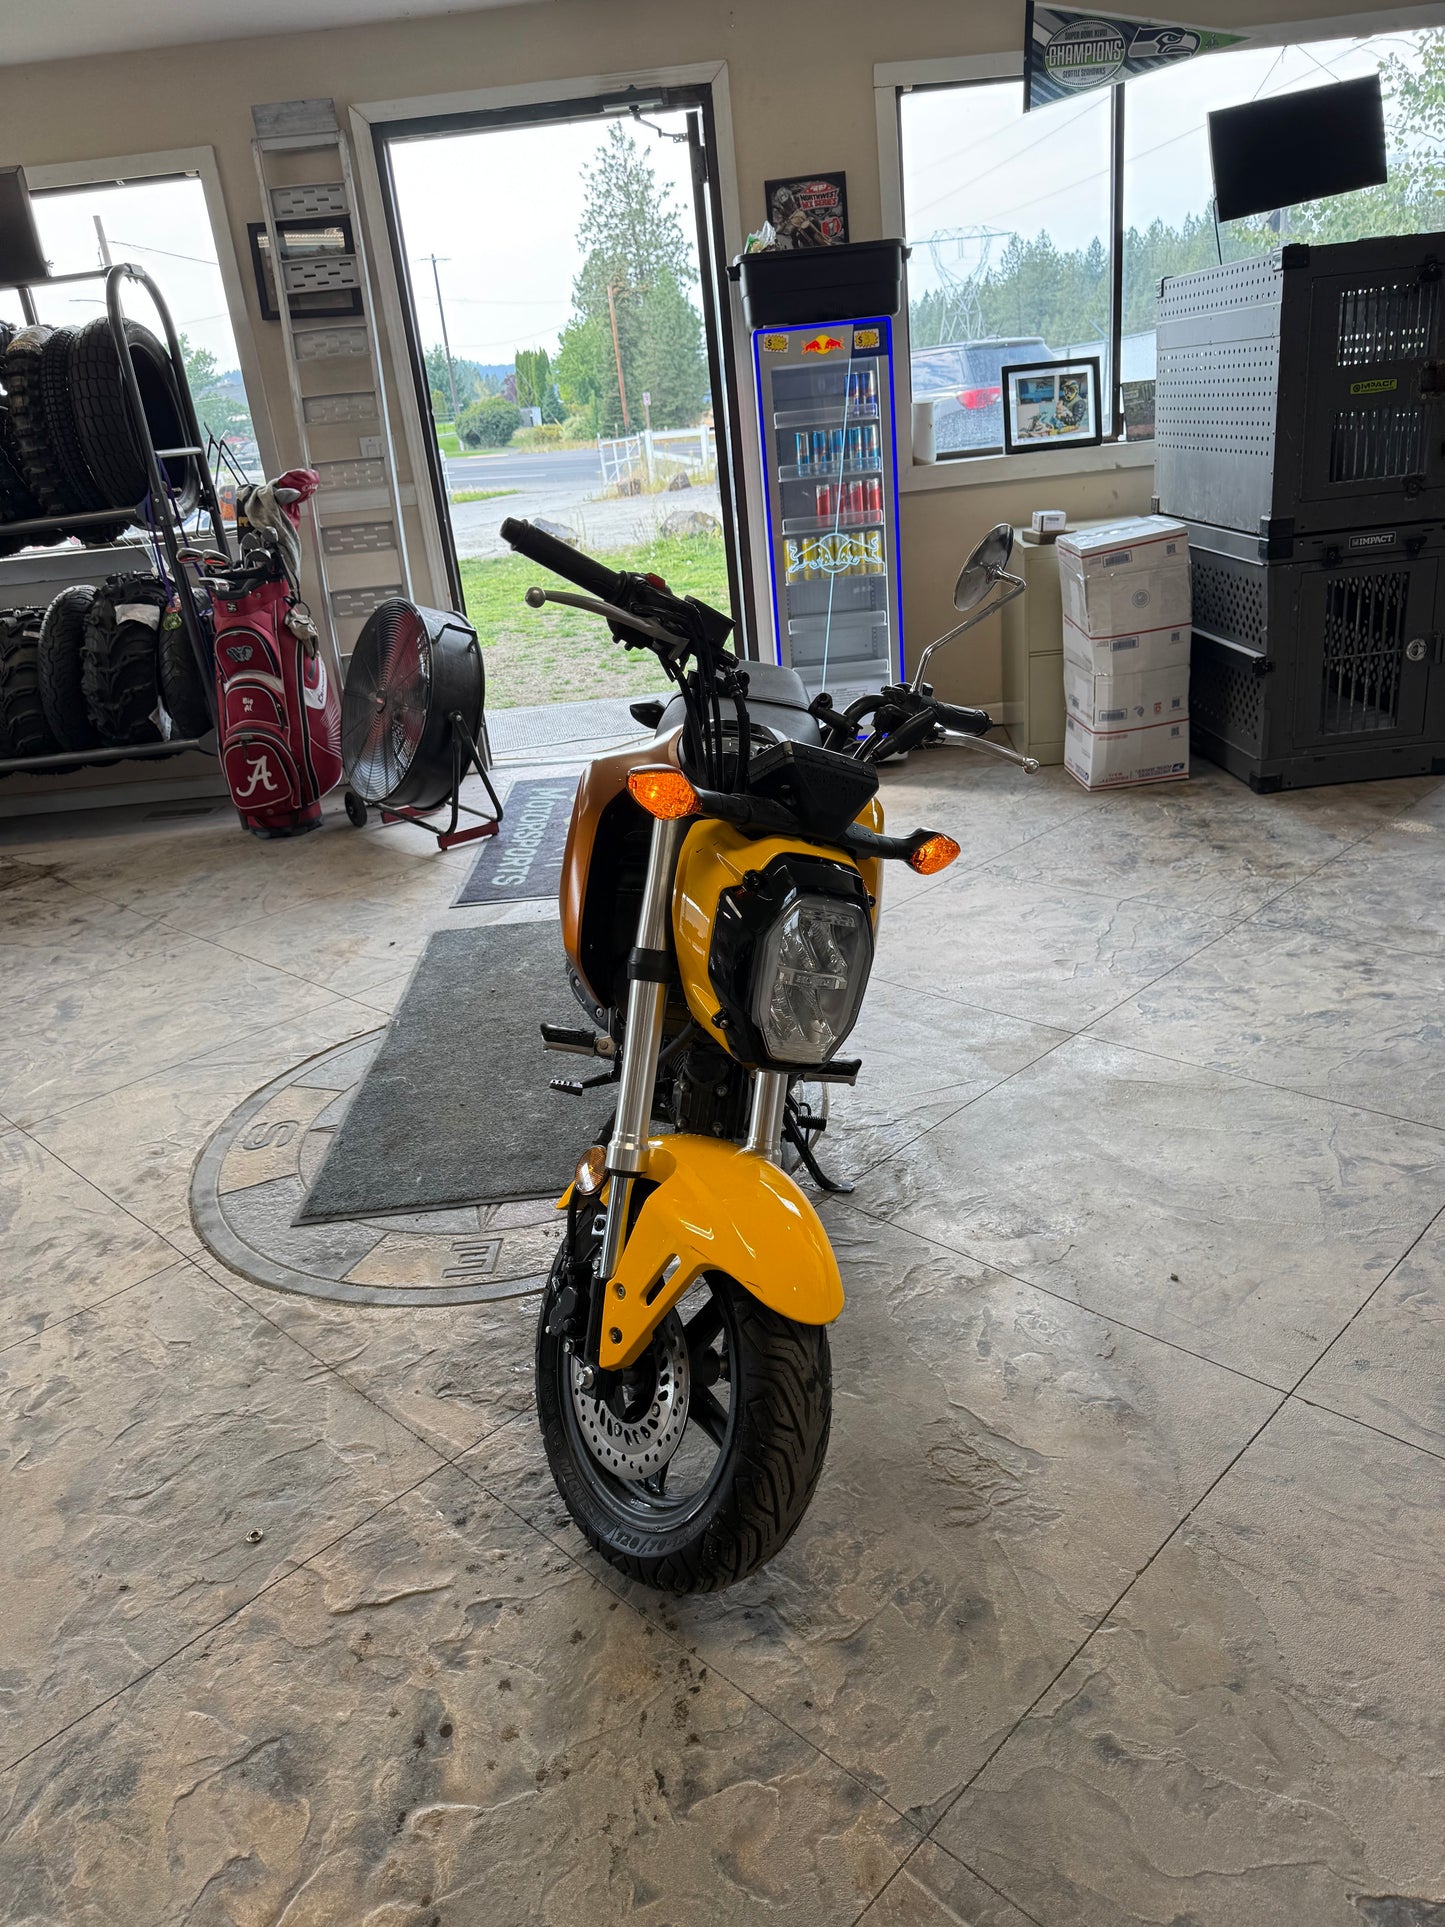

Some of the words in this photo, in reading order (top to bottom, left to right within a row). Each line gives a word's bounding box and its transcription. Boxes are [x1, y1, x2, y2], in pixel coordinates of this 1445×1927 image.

[1049, 40, 1122, 67] CHAMPIONS
[800, 190, 838, 201] NORTHWEST
[1361, 380, 1396, 390] IMPACT
[1360, 535, 1393, 545] IMPACT
[242, 697, 254, 706] Big
[236, 754, 278, 798] A
[491, 787, 570, 886] MOTORSPORTS
[242, 1118, 300, 1151] S
